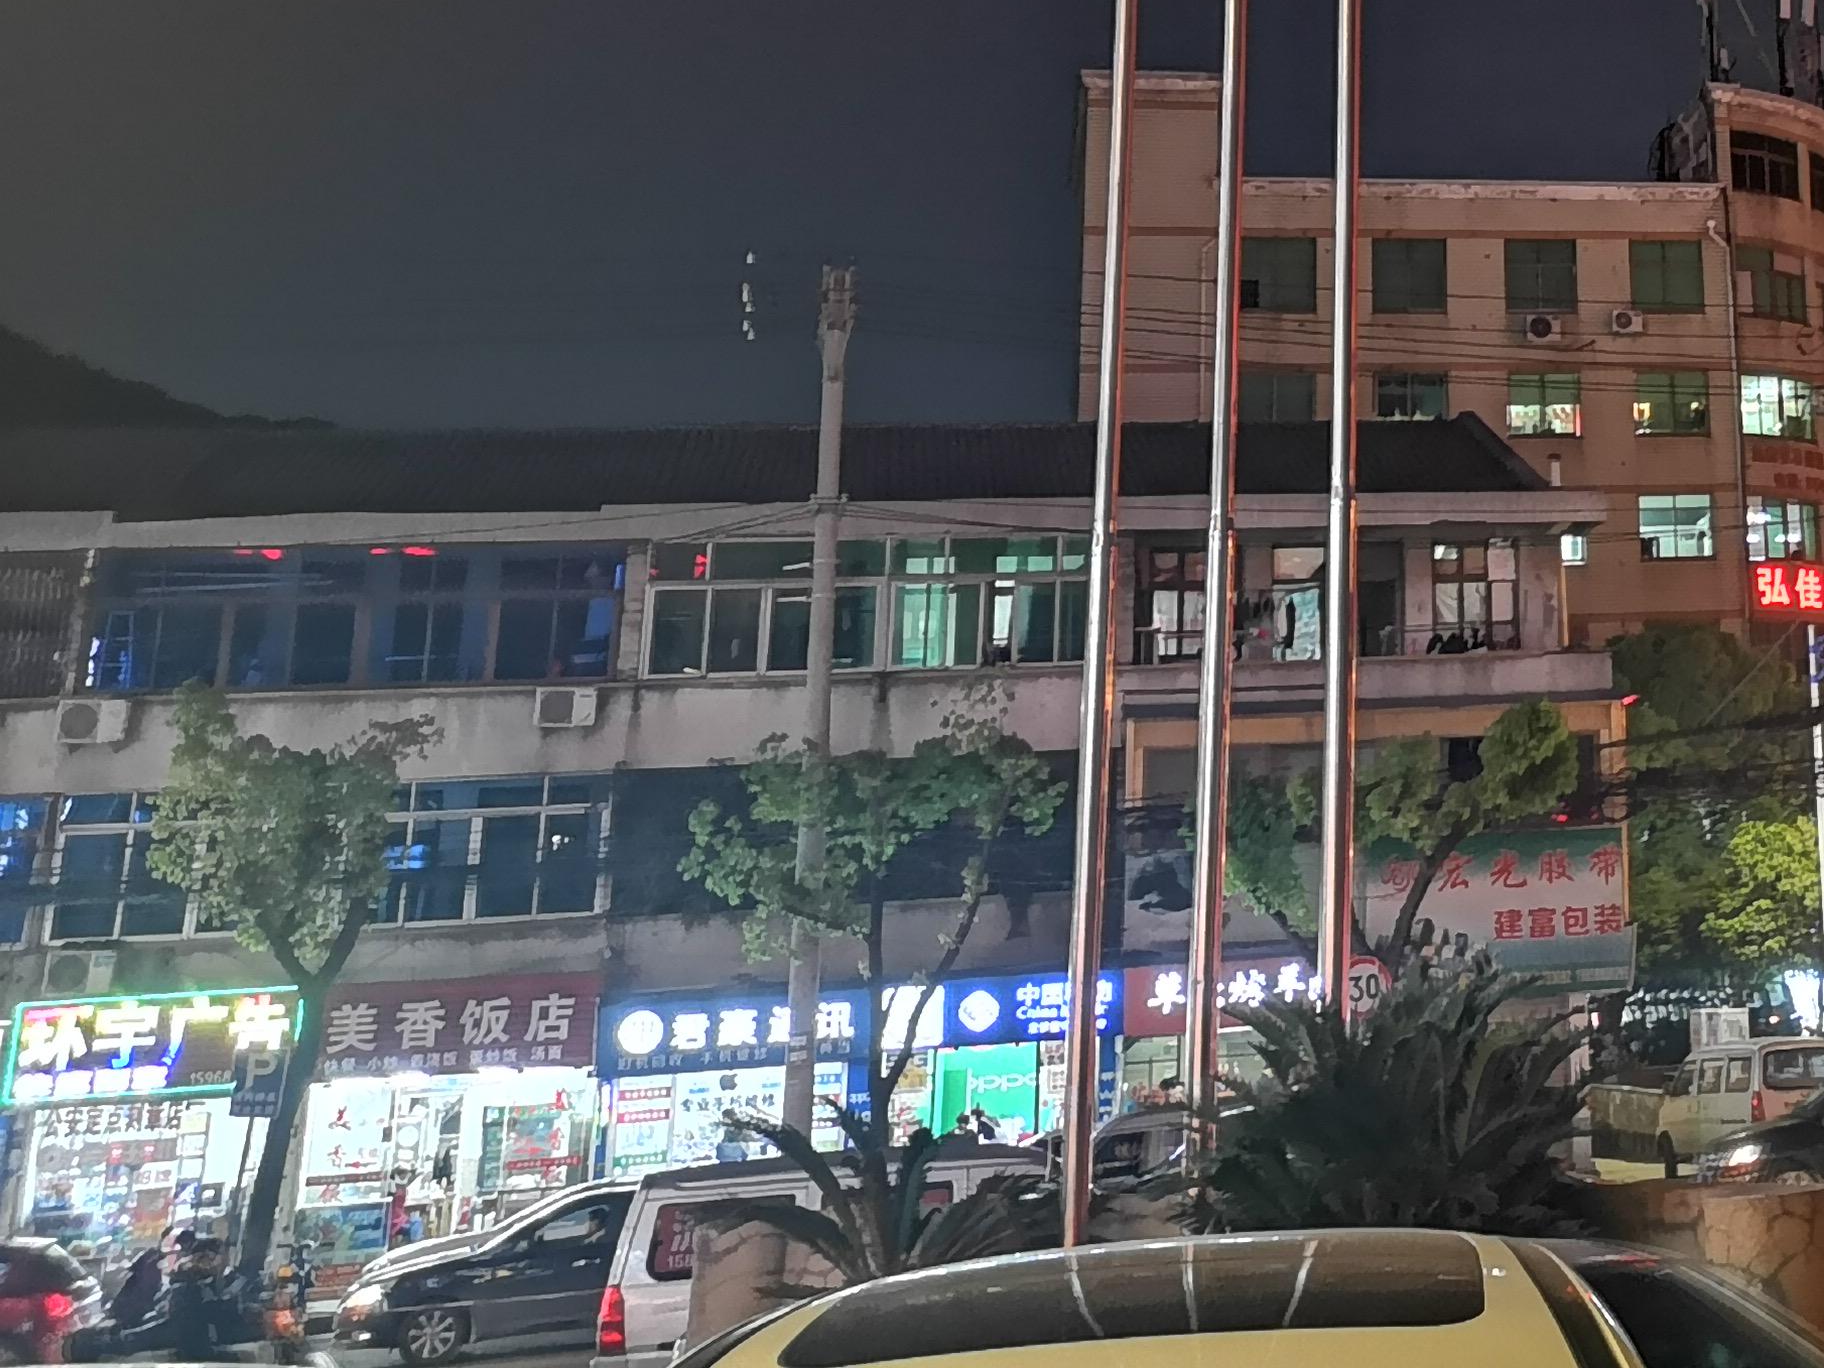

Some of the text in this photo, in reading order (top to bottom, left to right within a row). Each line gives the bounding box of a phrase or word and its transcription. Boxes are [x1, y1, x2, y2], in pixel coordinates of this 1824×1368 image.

[1493, 903, 1622, 940] 建富包装
[1016, 979, 1113, 1006] 中国动
[1349, 973, 1379, 1002] 30
[18, 994, 290, 1071] 环宇广告
[326, 993, 576, 1054] 美香饭店
[246, 1053, 279, 1092] P
